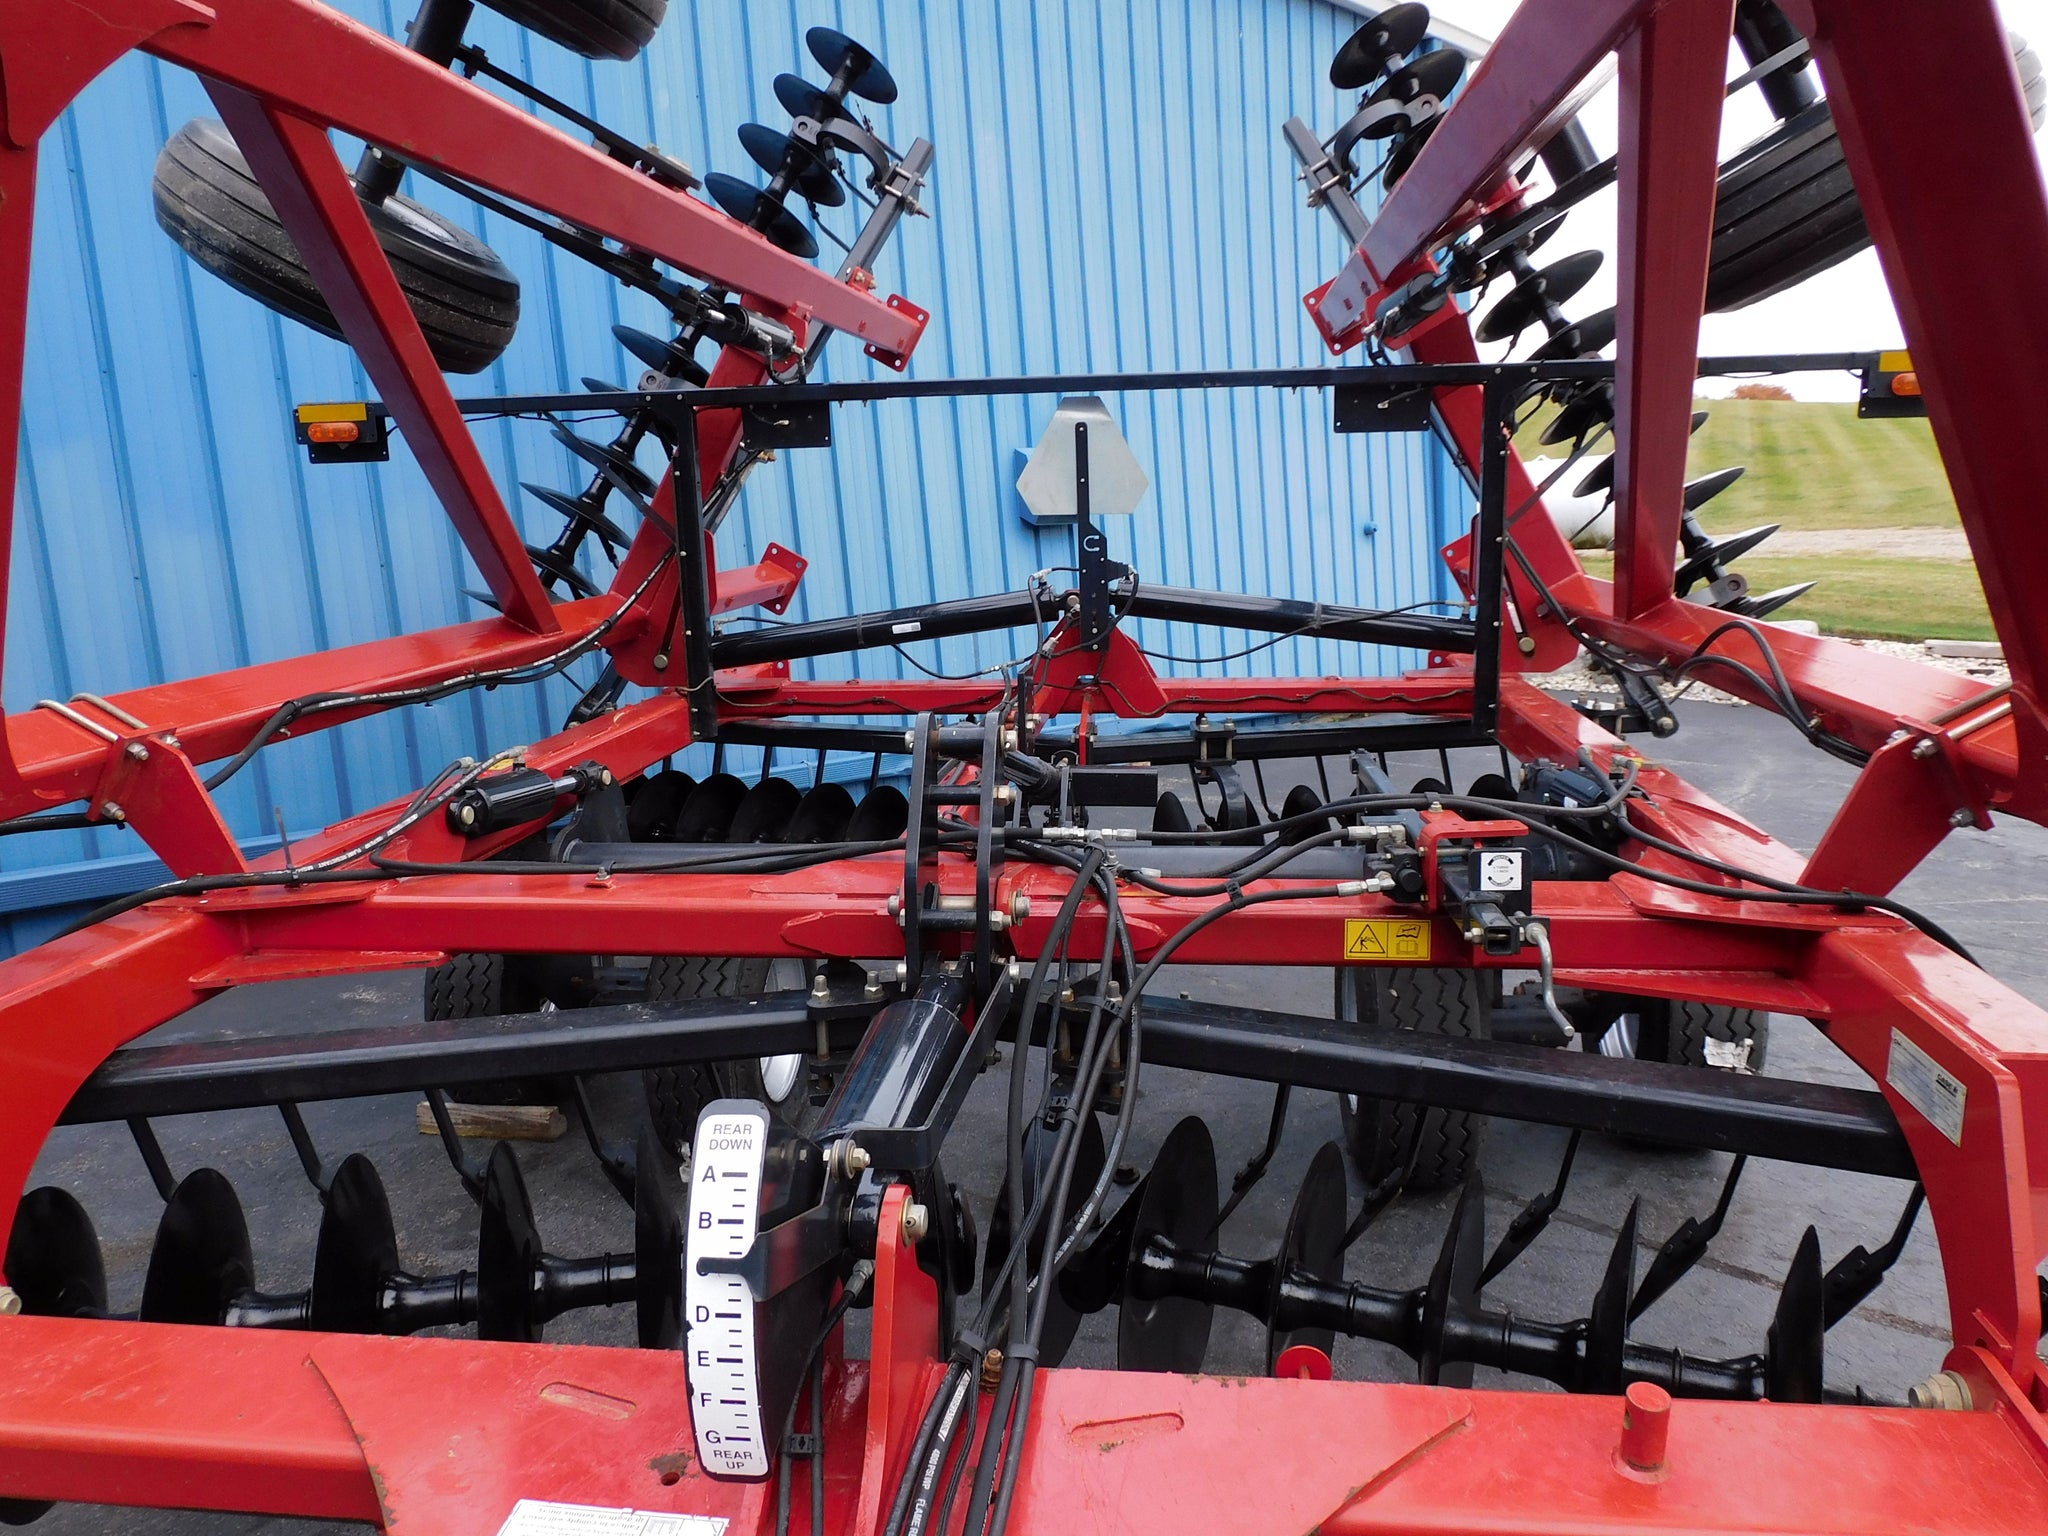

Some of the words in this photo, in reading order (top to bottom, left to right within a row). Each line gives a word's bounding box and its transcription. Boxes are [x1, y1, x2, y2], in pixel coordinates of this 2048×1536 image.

[713, 1124, 752, 1135] REAR
[709, 1139, 752, 1151] DOWN
[702, 1165, 716, 1183] A
[698, 1211, 712, 1229] B
[696, 1305, 710, 1323] D
[697, 1350, 710, 1367] E
[700, 1393, 712, 1407] F
[705, 1430, 721, 1444] G
[713, 1449, 752, 1460] REAR
[726, 1461, 744, 1470] UP
[911, 1499, 925, 1527] FLAME
